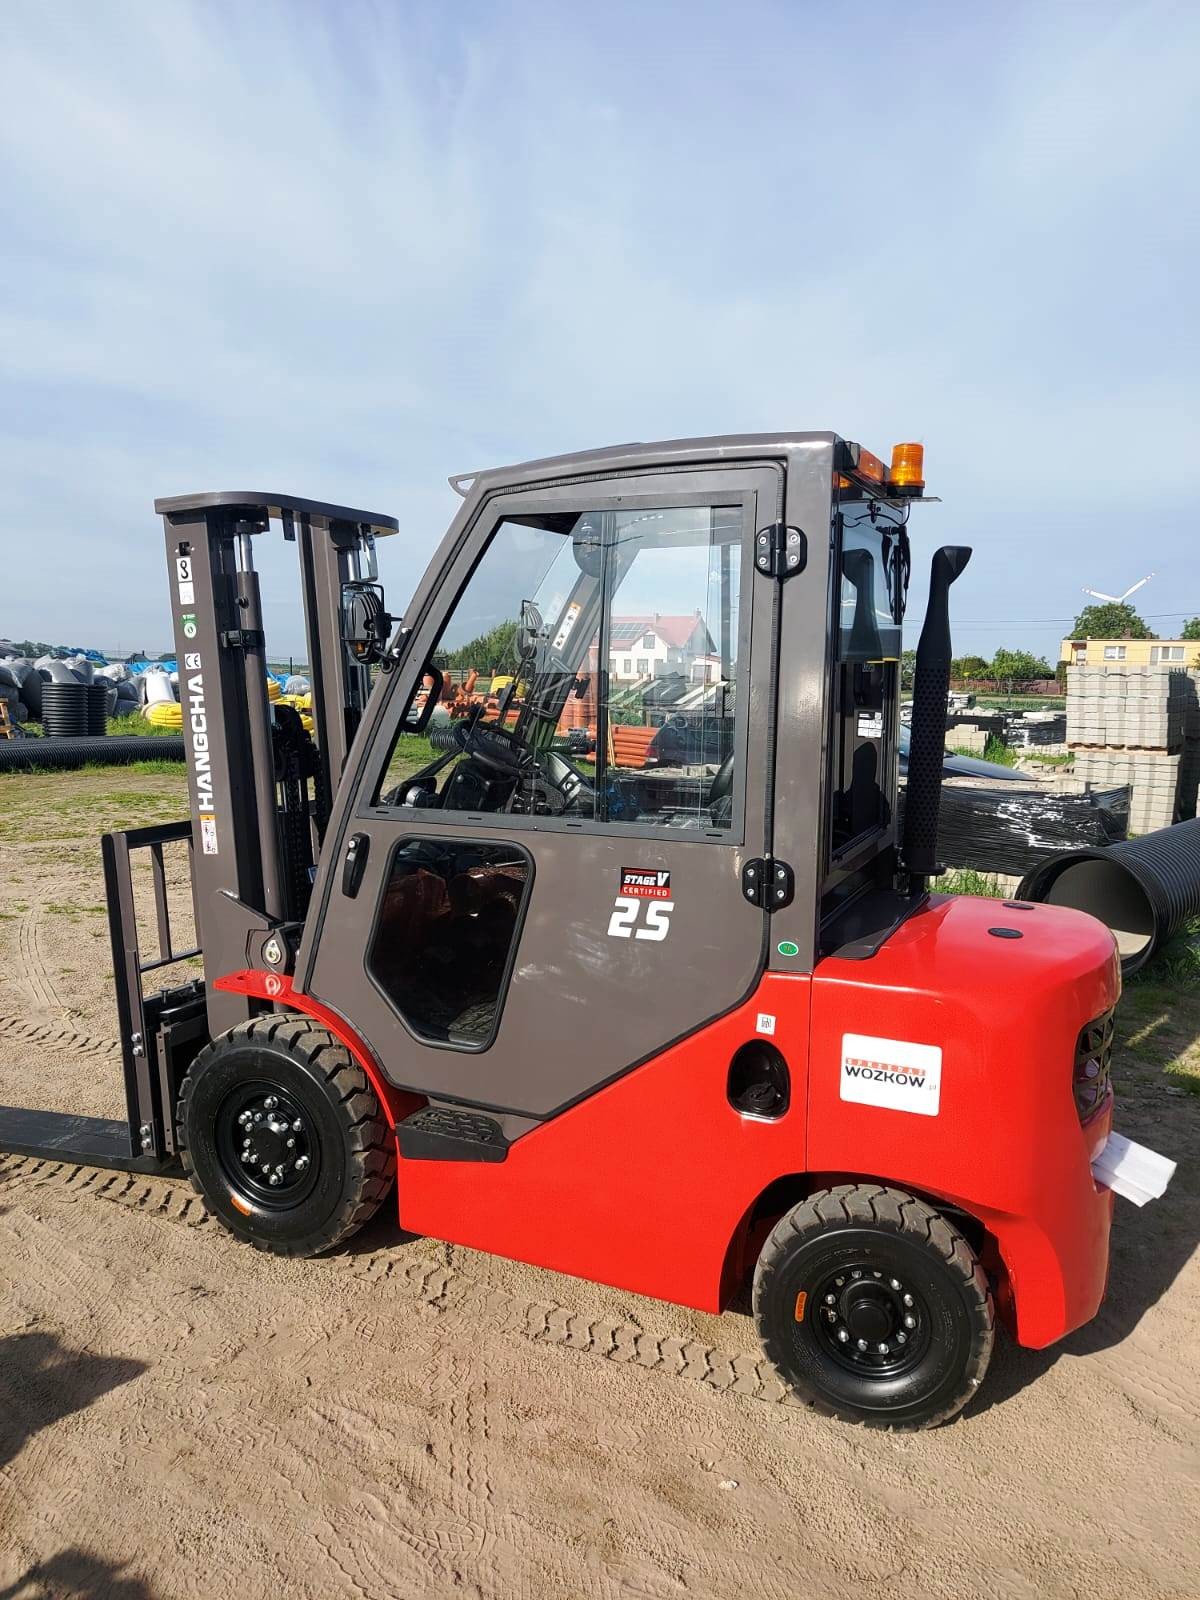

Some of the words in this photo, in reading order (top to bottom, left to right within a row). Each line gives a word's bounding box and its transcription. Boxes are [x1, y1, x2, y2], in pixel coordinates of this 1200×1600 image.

[188, 674, 214, 811] HANGCHA
[623, 886, 668, 897] CERTIFIED
[607, 897, 675, 942] 25
[845, 1065, 925, 1088] WOZKOW
